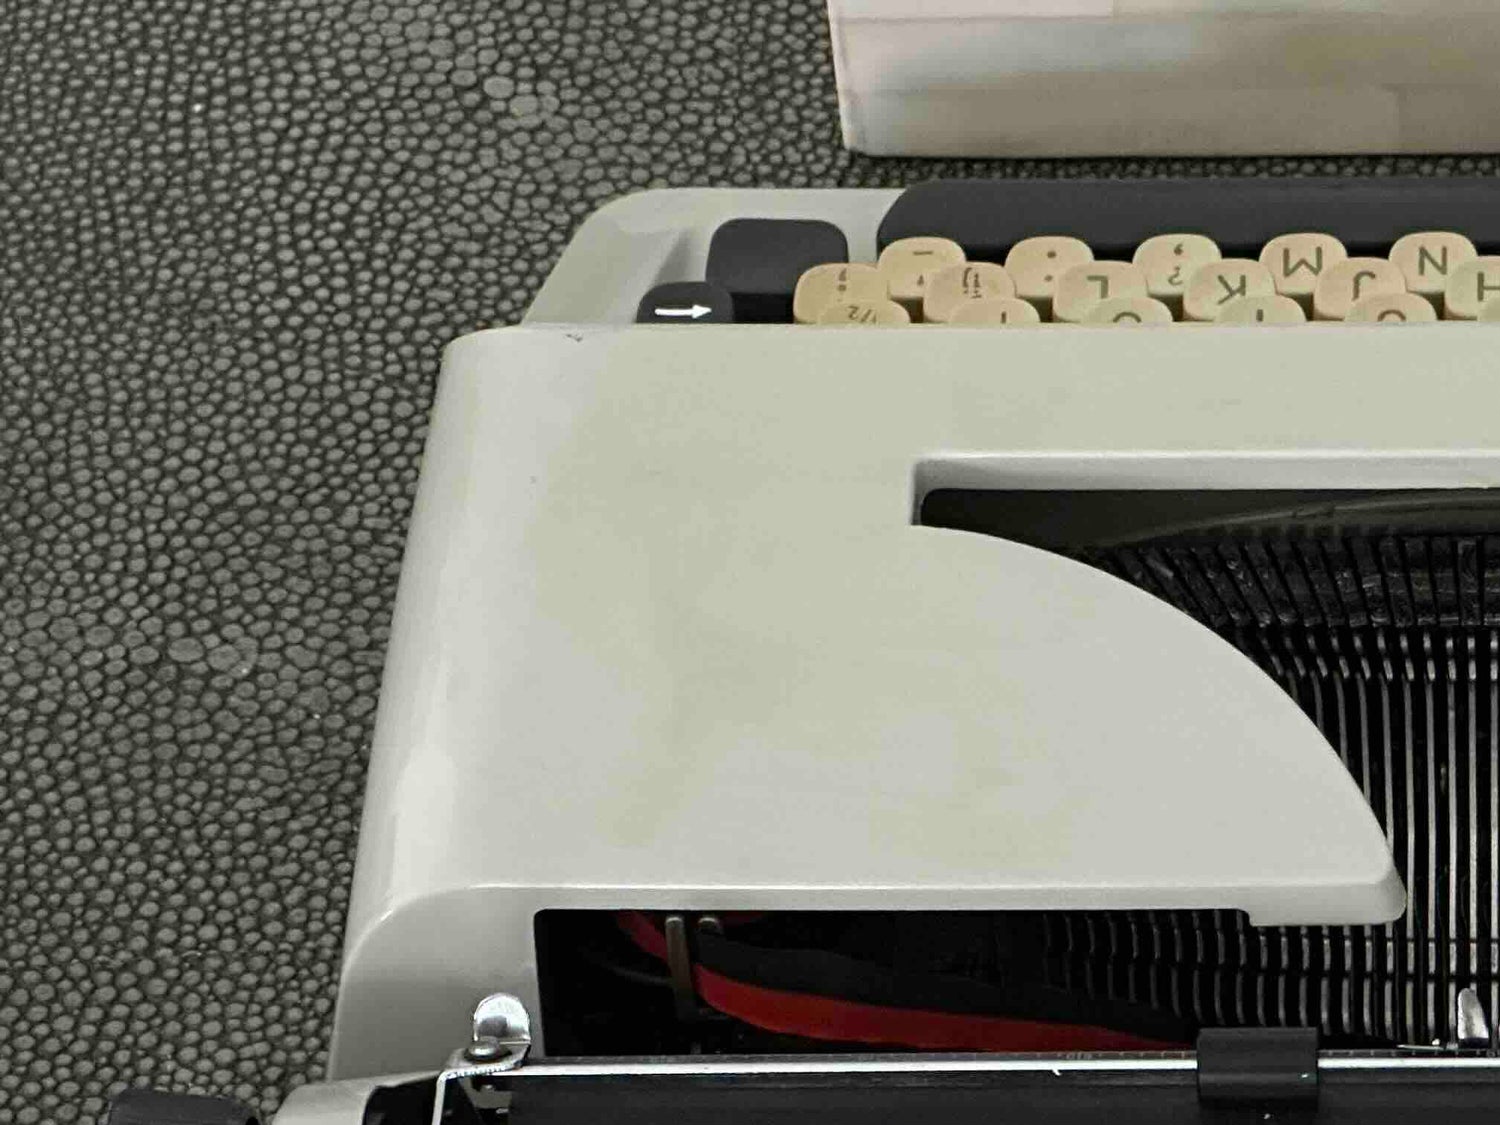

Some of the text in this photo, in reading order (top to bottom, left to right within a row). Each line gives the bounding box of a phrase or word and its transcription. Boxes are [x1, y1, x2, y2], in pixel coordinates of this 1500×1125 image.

[1282, 246, 1323, 278] M
[1418, 245, 1448, 276] N
[1086, 274, 1109, 300] L
[1217, 273, 1247, 305] K
[1352, 270, 1377, 301] J
